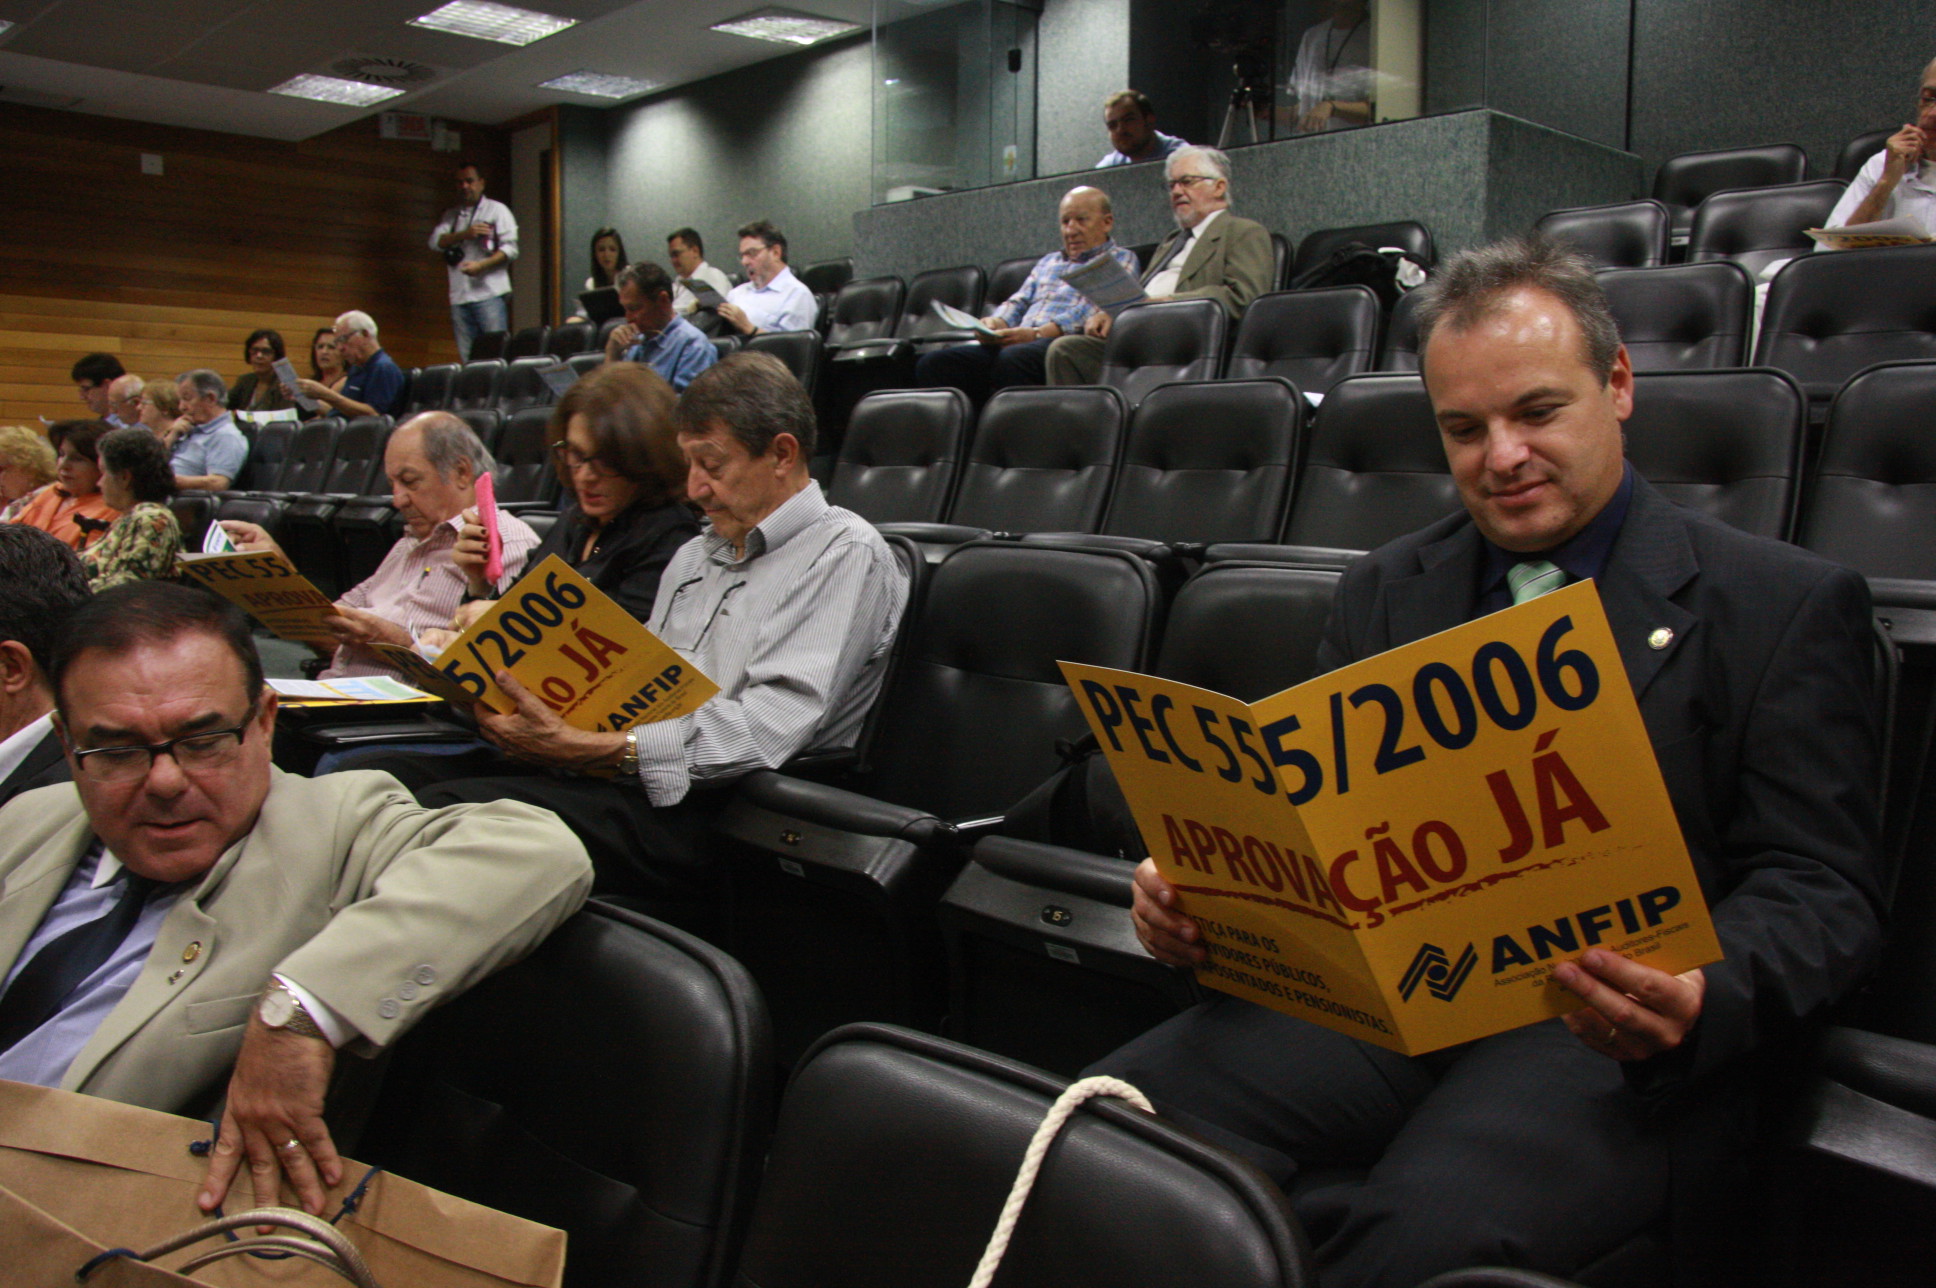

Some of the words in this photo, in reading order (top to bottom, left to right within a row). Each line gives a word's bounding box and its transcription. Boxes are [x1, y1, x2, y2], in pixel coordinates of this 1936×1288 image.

[188, 560, 256, 582] PEC
[558, 617, 628, 683] JÁ
[607, 664, 683, 731] ANFIP
[1079, 679, 1204, 773] PEC
[1485, 727, 1611, 864] JÁ
[1227, 926, 1260, 947] PARA
[1261, 936, 1280, 954] OS
[1492, 886, 1682, 974] ANFIP
[1285, 987, 1295, 1001] E
